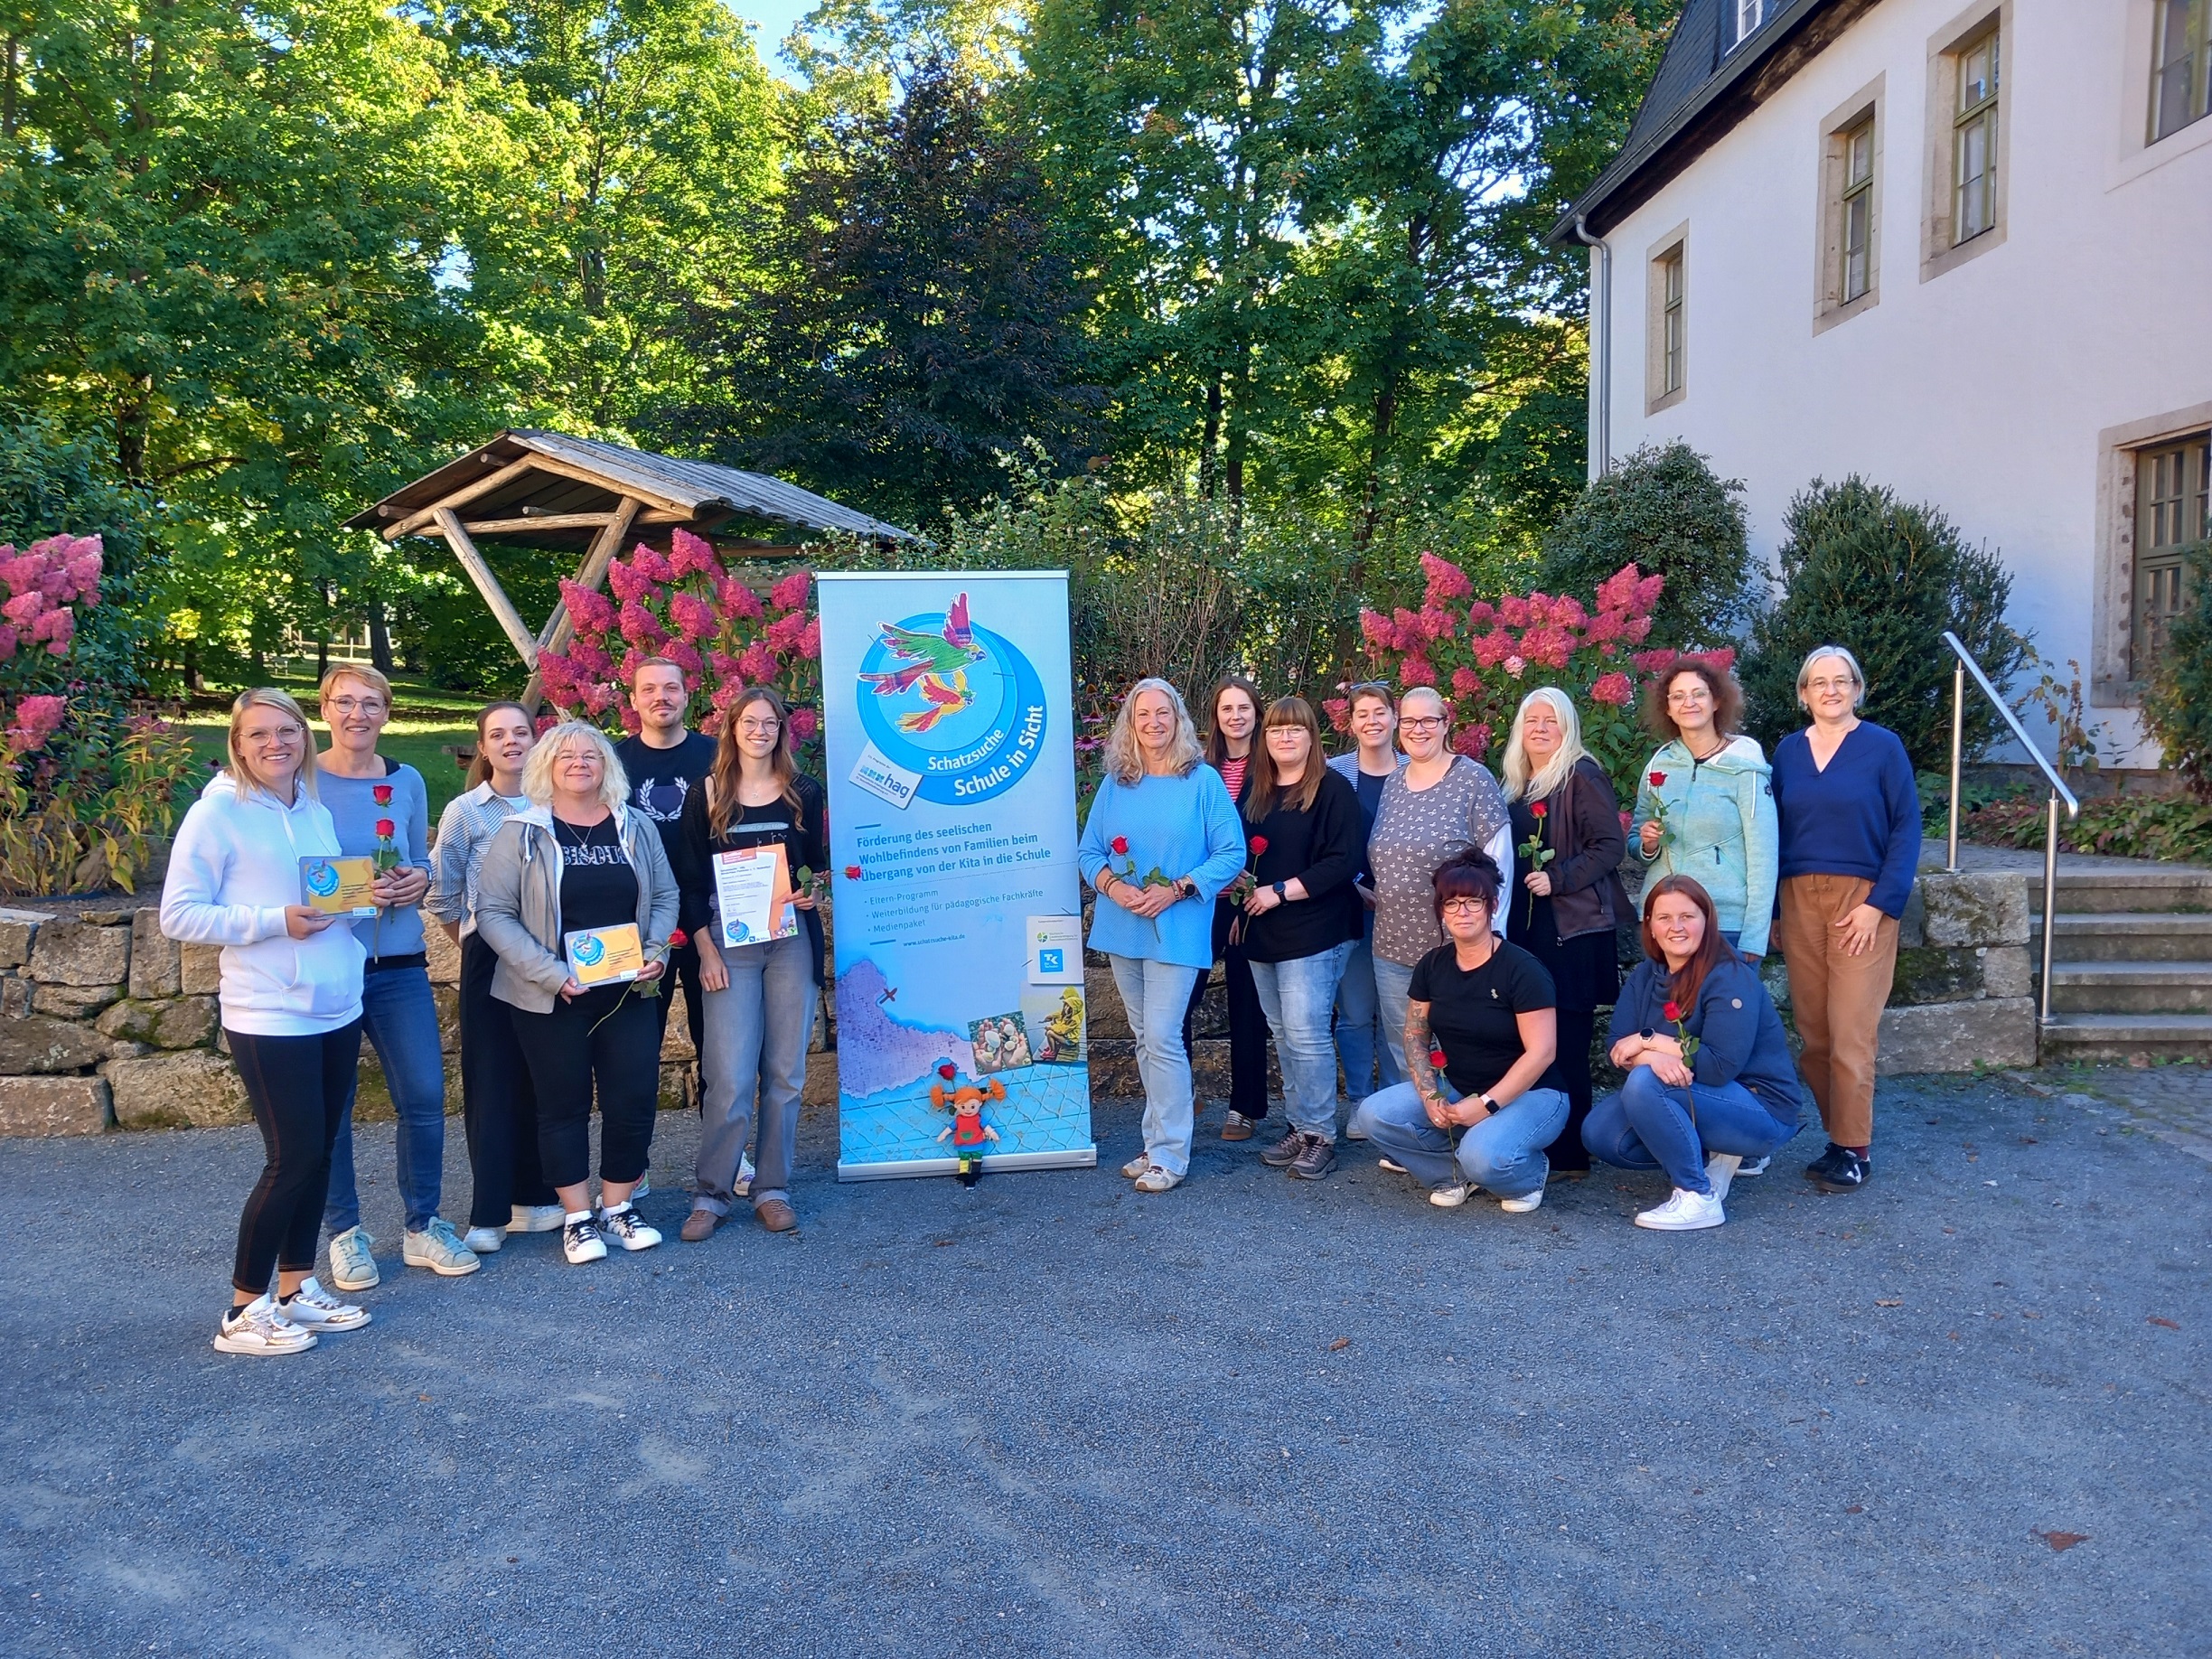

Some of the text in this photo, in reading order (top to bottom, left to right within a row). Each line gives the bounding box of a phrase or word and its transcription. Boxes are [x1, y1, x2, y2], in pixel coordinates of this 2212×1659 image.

[927, 728, 1004, 771] Schatzsuche
[954, 705, 1044, 796] Schule in Sicht
[884, 773, 910, 799] hag
[857, 822, 992, 848] Förderung des seelischen
[858, 833, 1038, 865] Wohlbefindens von Familien beim
[861, 848, 1051, 882] Übergang von der Kita in die Schule
[869, 889, 939, 904] Eltern-Programm
[871, 888, 1044, 919] Weiterbildung für pädagogische Fachkräfte
[873, 919, 926, 933] Medienpaket
